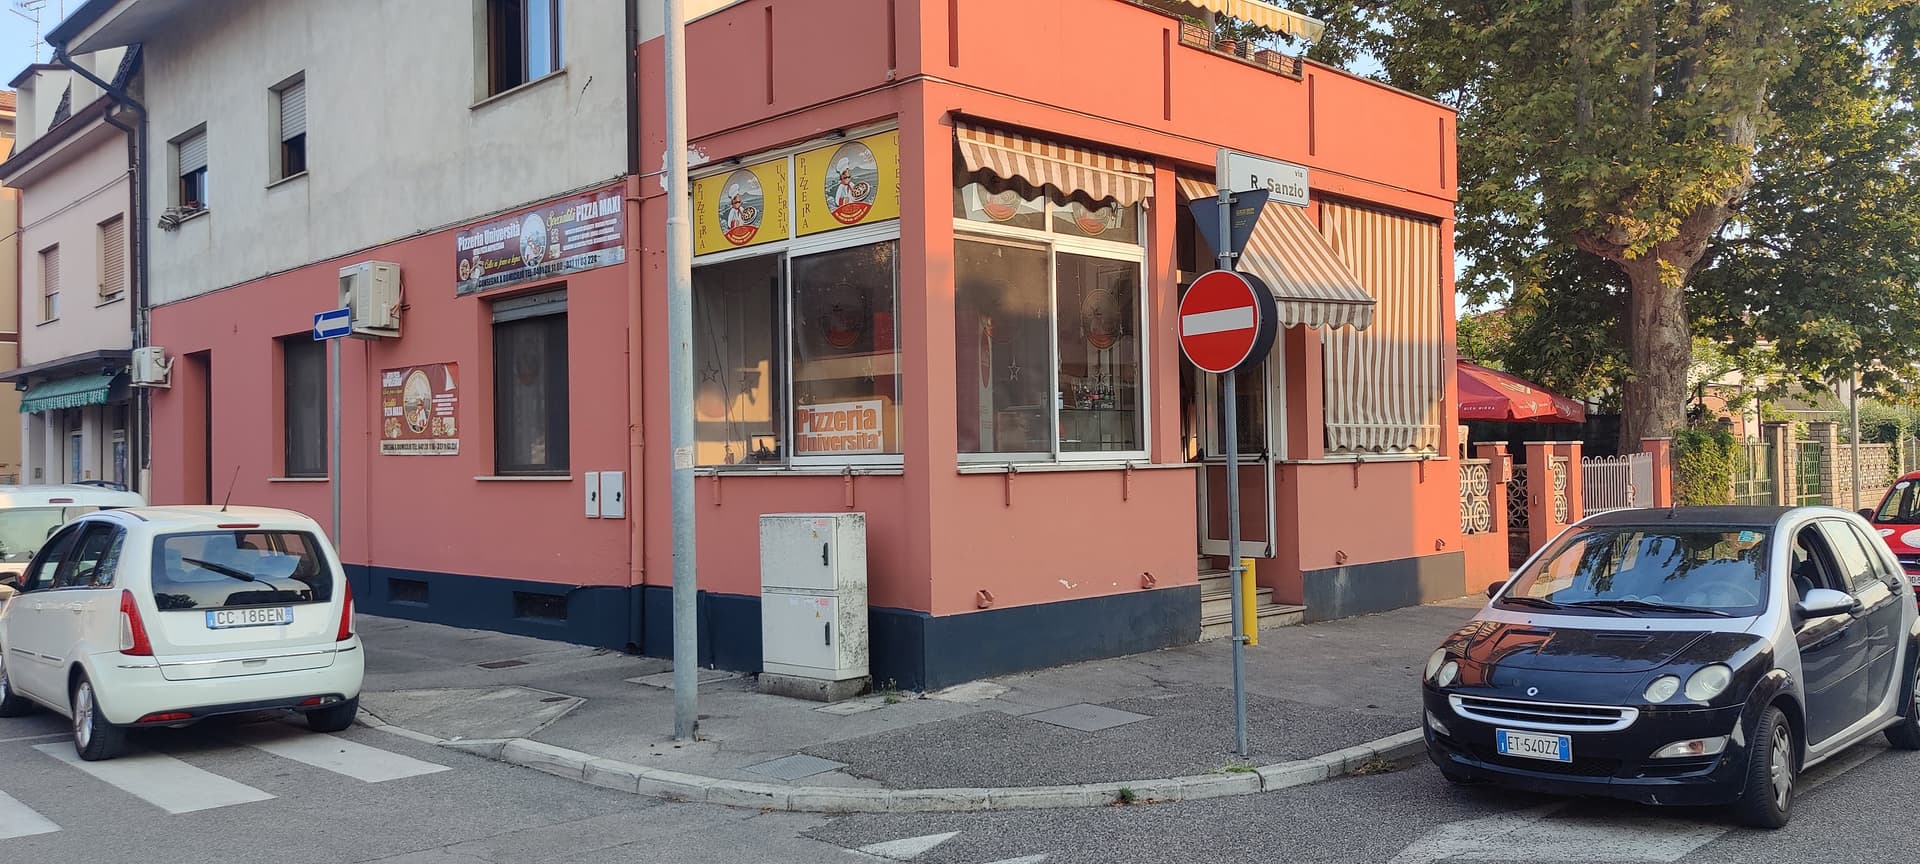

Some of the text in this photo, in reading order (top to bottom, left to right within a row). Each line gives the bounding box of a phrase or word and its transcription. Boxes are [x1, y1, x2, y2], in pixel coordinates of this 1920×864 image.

[799, 157, 811, 229] PIZZERIA
[1267, 177, 1304, 198] Sanzio
[576, 201, 598, 222] PIZZA
[599, 195, 621, 217] MAXI
[697, 183, 707, 249] PIZZERIA
[457, 232, 484, 252] Pizzeria
[797, 405, 877, 433] Pizzeria
[797, 431, 881, 452] Universita'
